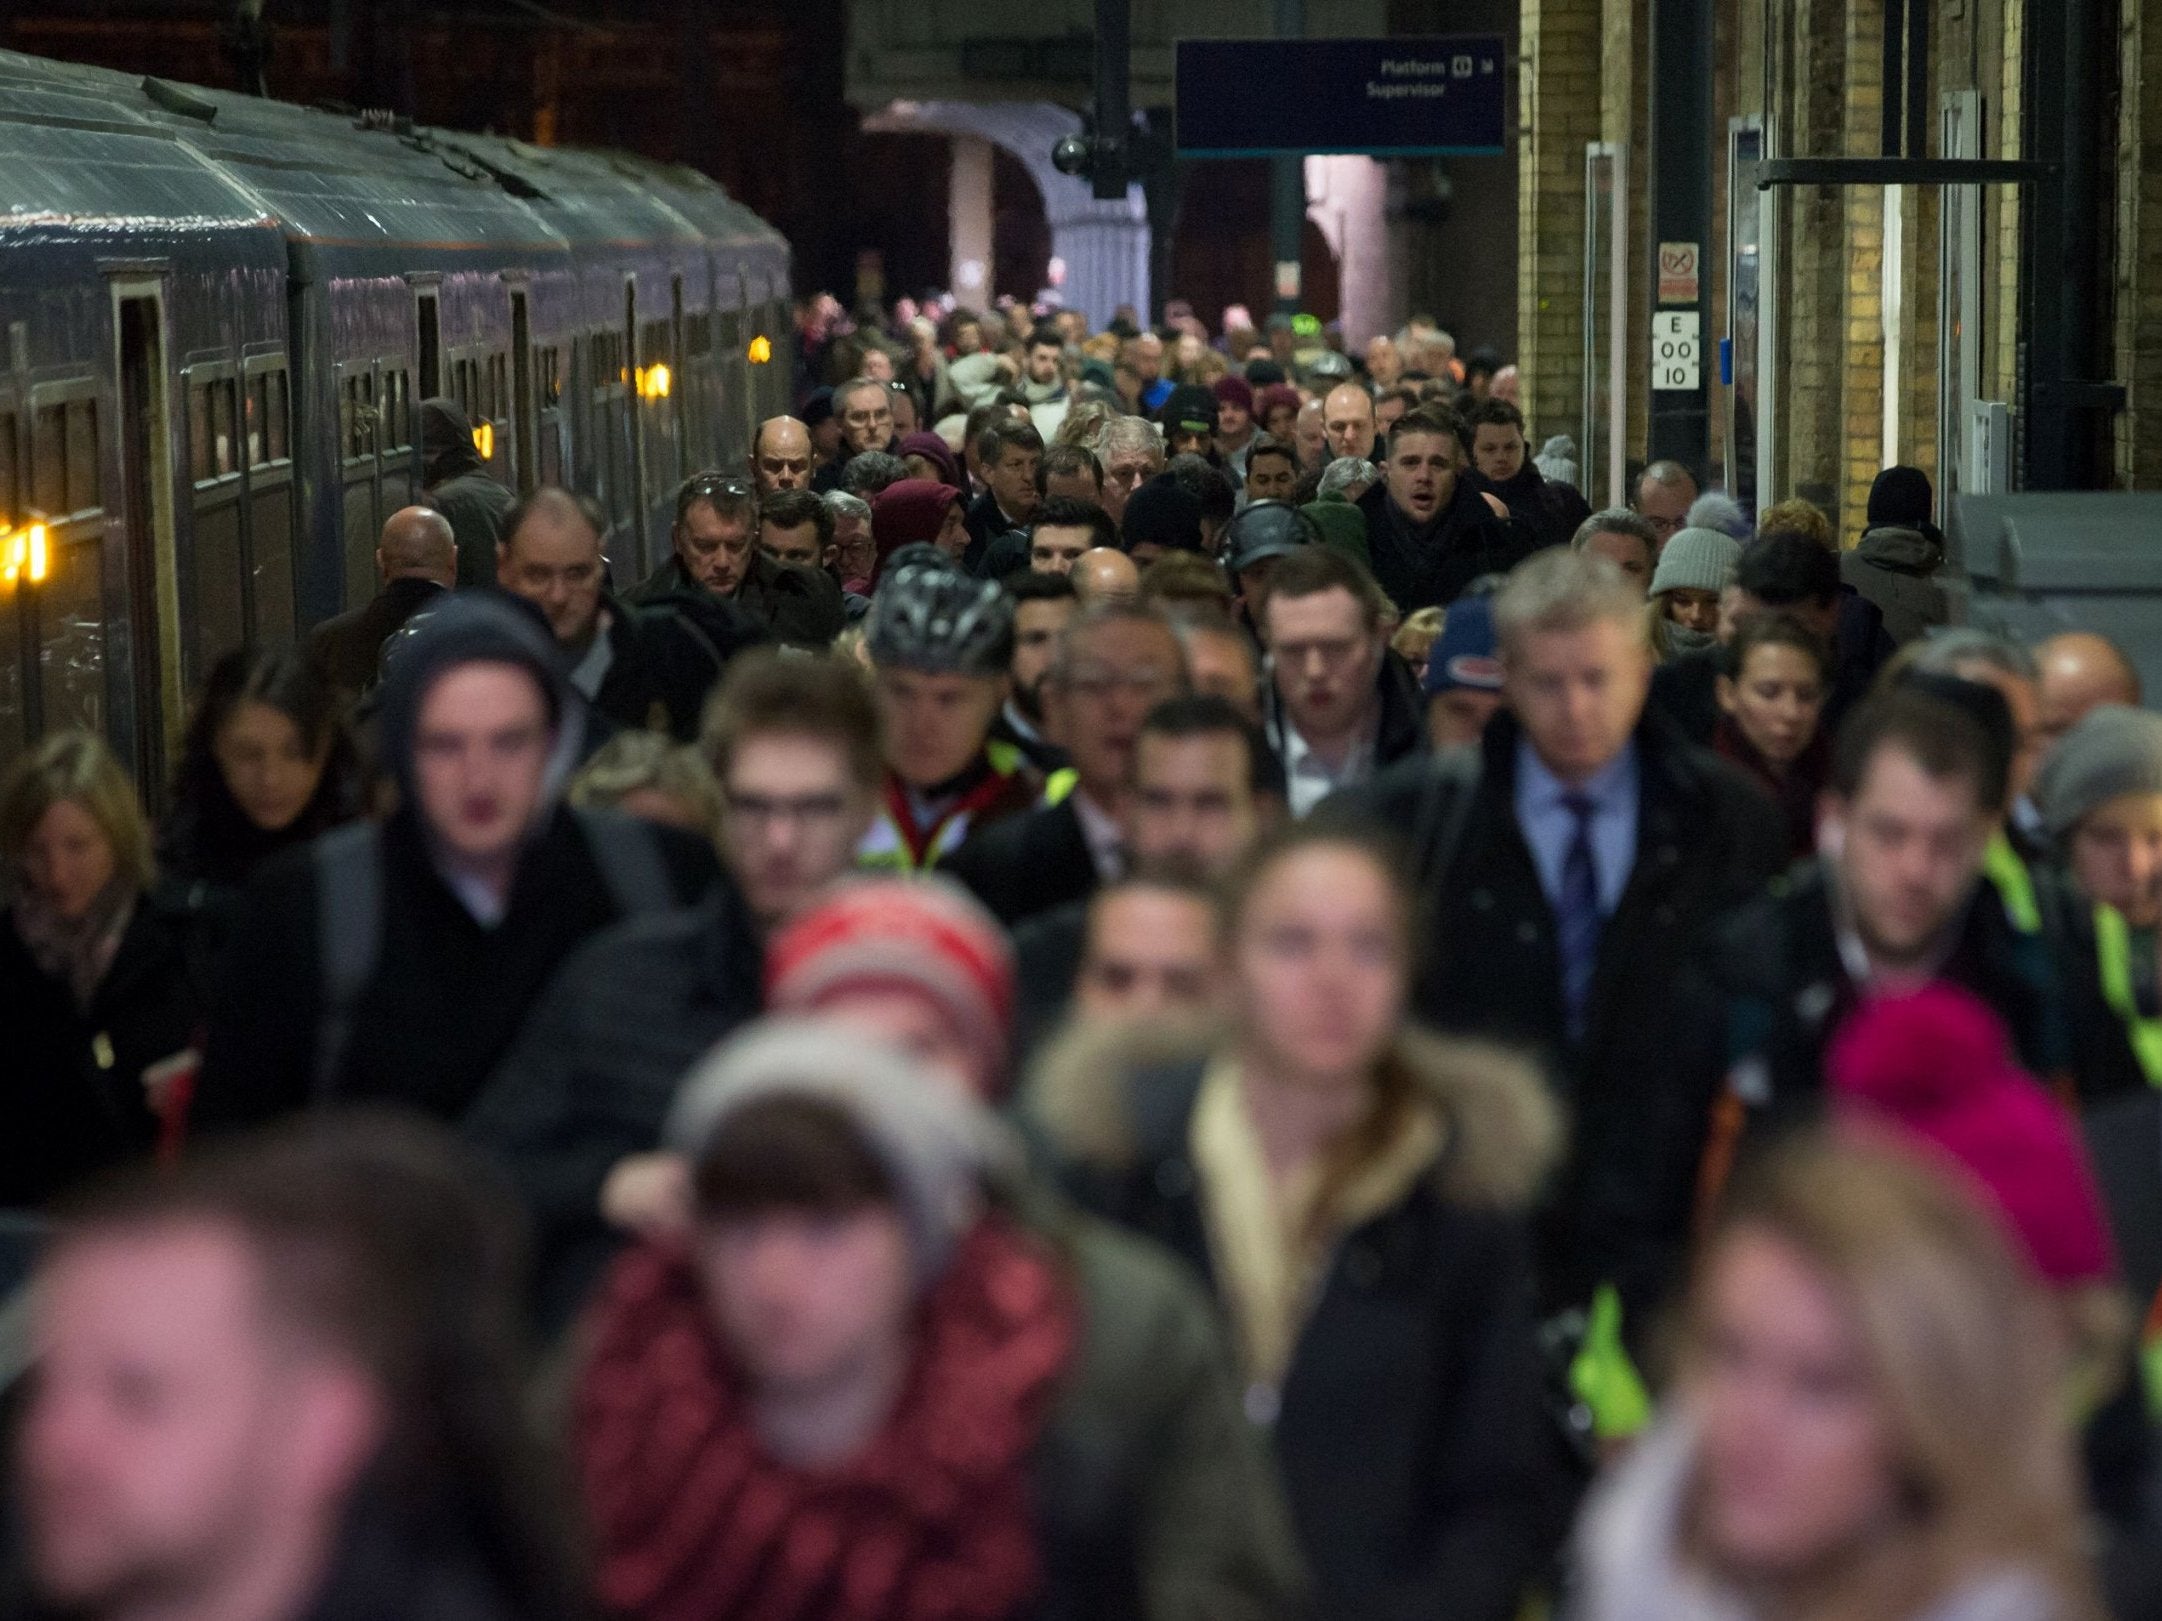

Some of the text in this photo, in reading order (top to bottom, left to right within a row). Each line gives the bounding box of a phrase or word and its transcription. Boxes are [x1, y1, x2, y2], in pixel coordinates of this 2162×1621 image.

[1381, 59, 1445, 75] Platform
[1366, 81, 1445, 99] Supervisor
[1671, 316, 1682, 333] E
[1661, 341, 1691, 359] 00
[1666, 367, 1685, 385] 10
